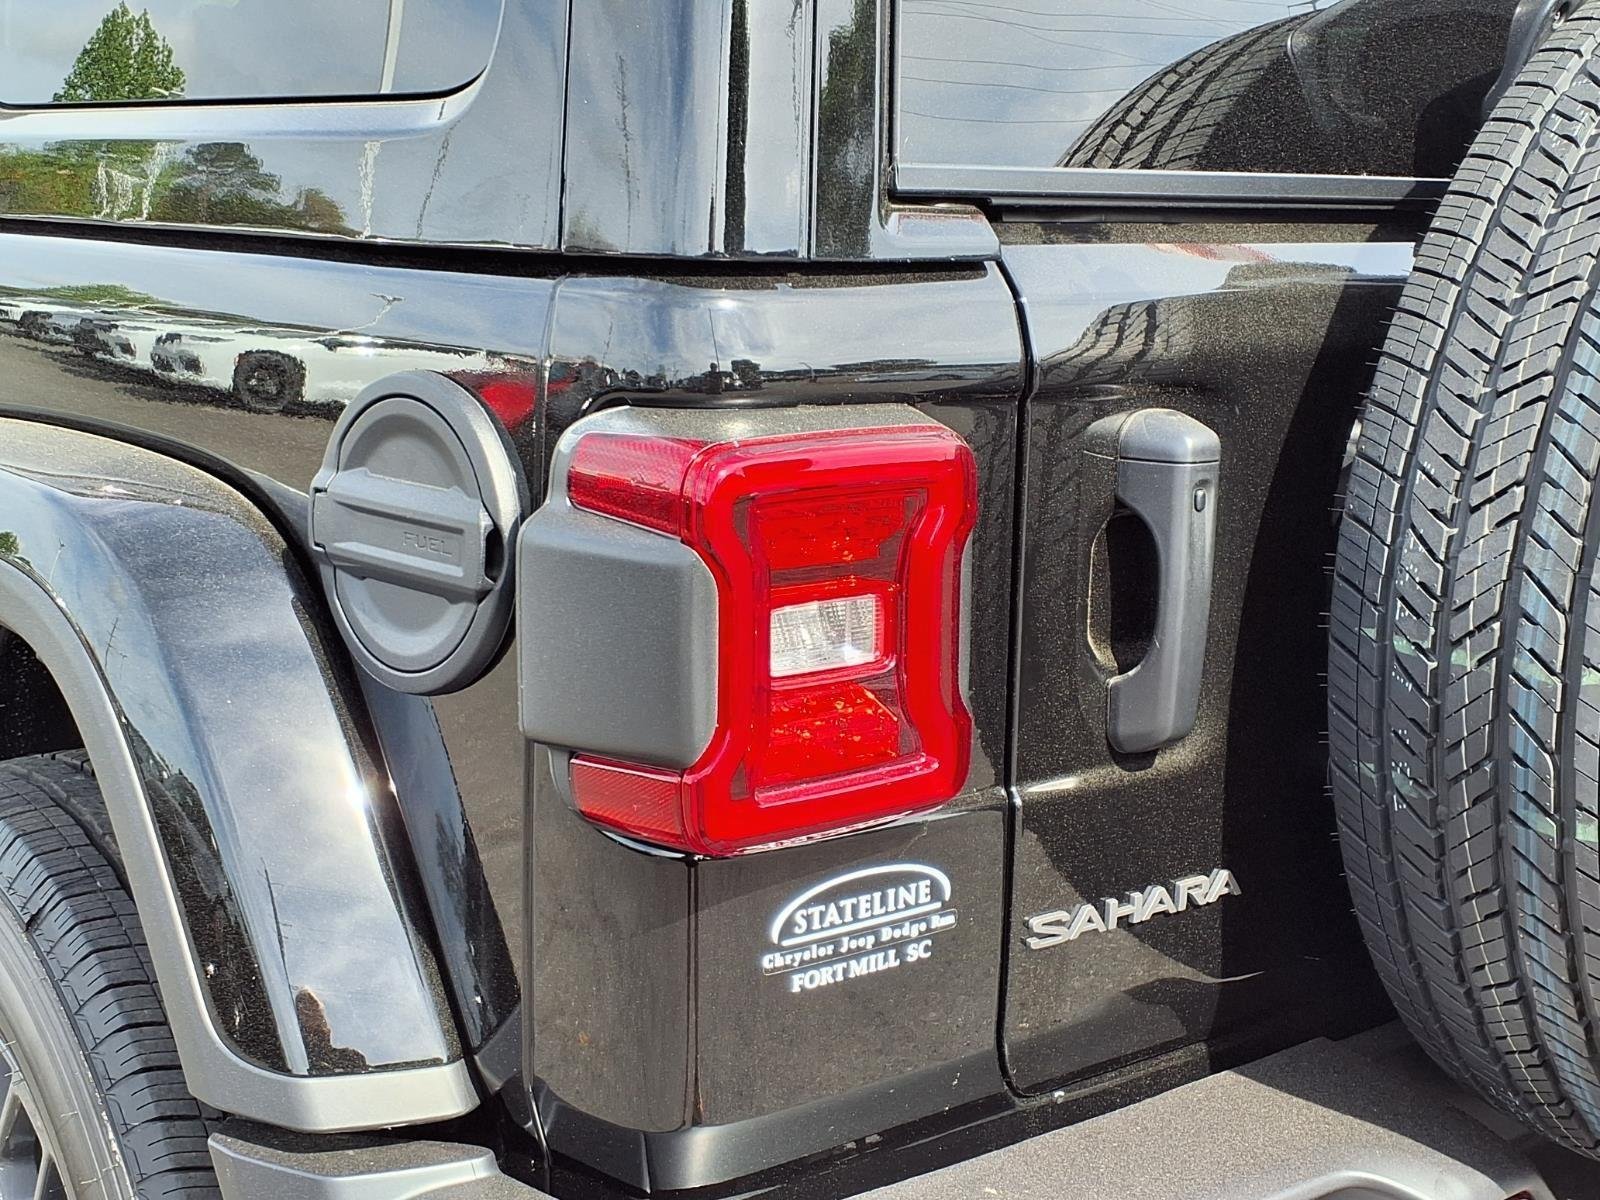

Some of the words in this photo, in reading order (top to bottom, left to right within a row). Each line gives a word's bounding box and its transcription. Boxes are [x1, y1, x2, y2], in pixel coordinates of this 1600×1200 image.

[403, 531, 452, 556] FUEL
[793, 879, 931, 934] STATELINE
[1022, 867, 1242, 950] SAHARA
[763, 944, 834, 968] Chrysler
[840, 934, 876, 953] Jeep
[880, 921, 928, 941] Dodge
[931, 913, 956, 930] Ram
[792, 964, 849, 992] FORT
[850, 949, 900, 978] MILL
[906, 940, 932, 962] SC
